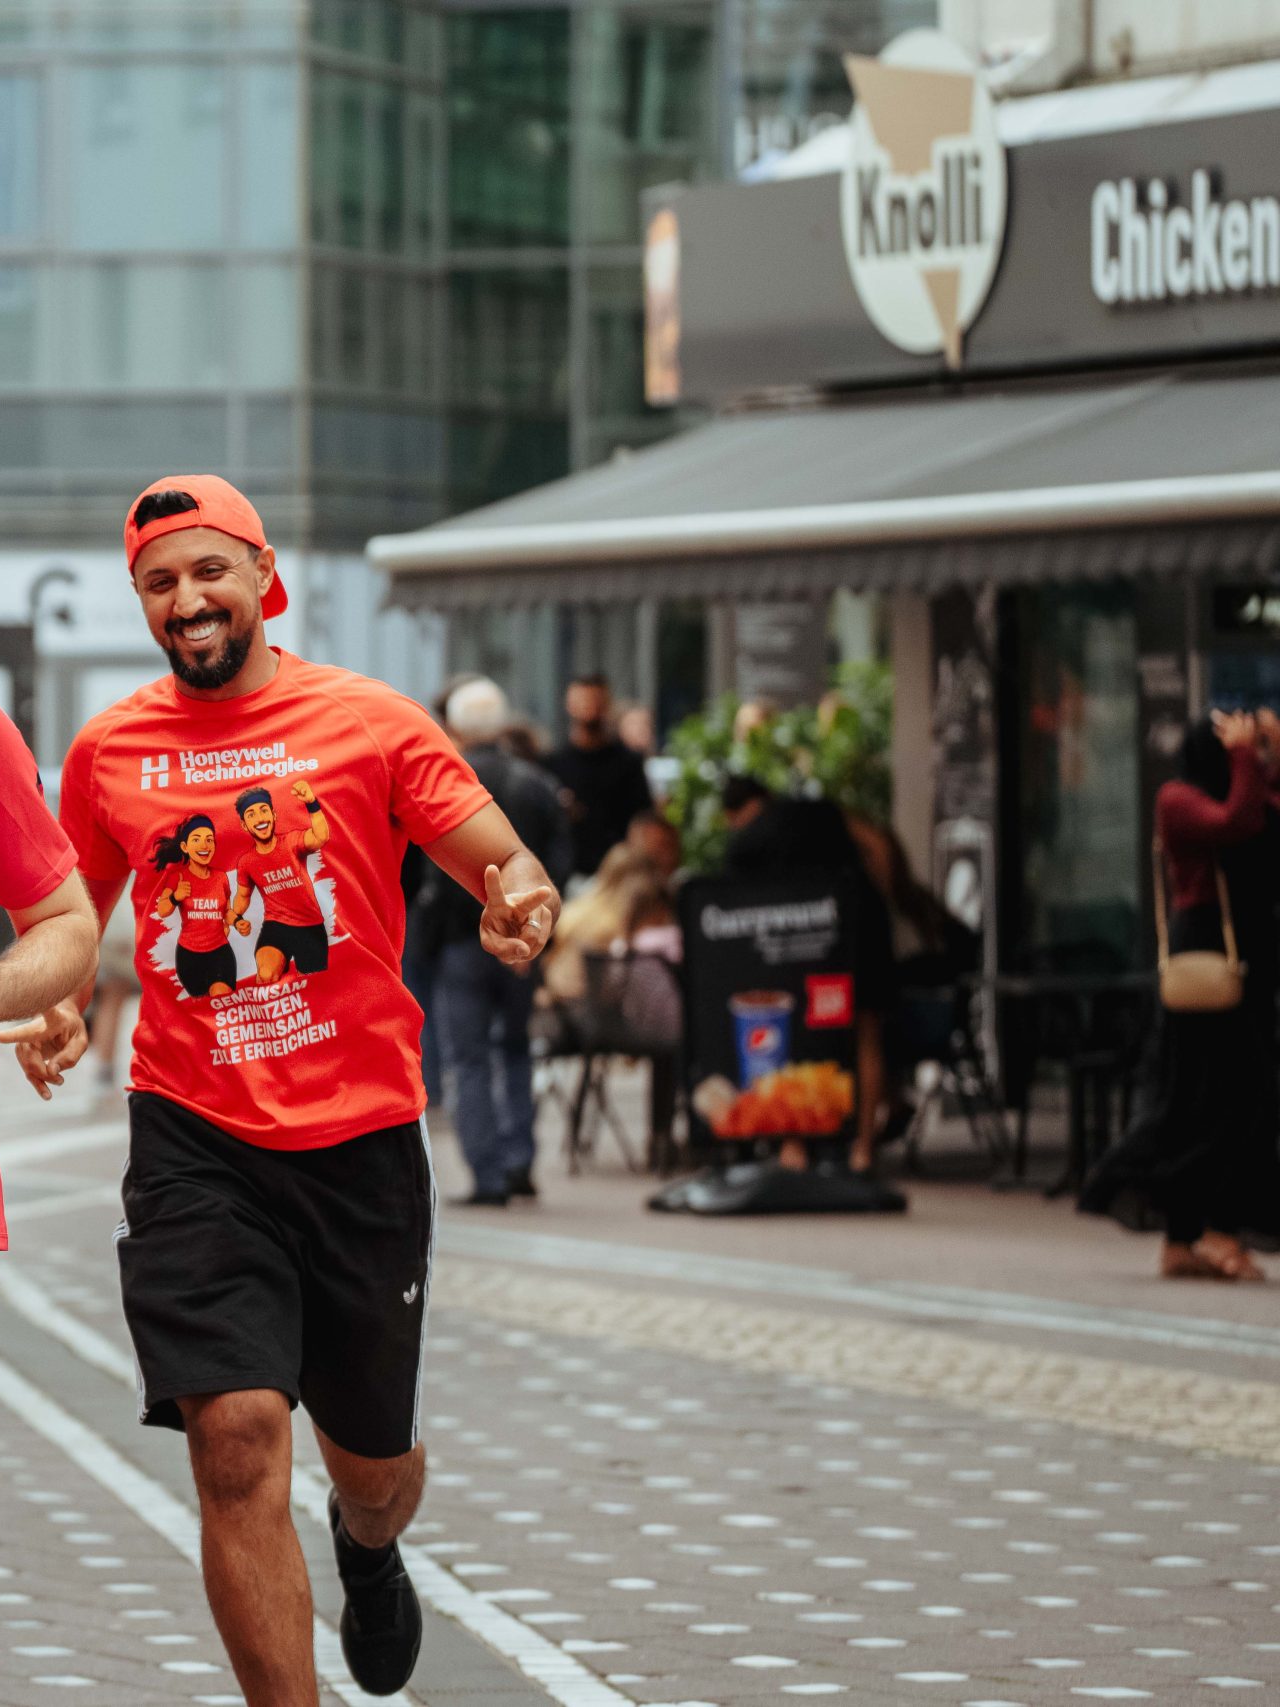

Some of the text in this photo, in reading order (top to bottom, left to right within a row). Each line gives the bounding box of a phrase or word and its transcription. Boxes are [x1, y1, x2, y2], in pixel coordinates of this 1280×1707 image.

[857, 144, 986, 261] Knolli
[1091, 169, 1280, 303] Chicken
[179, 742, 285, 769] Honeywell
[181, 757, 319, 785] Technologies
[263, 866, 294, 883] TEAM
[263, 877, 303, 895] HONEYWELL
[187, 911, 222, 920] HONEYWELL
[193, 898, 218, 910] TEAM
[210, 979, 308, 1010] GEMEINSAM
[215, 993, 308, 1027] SCHWITZEN.
[216, 1009, 312, 1046] GEMEINSAM
[244, 1020, 337, 1060] ERREICHEN!
